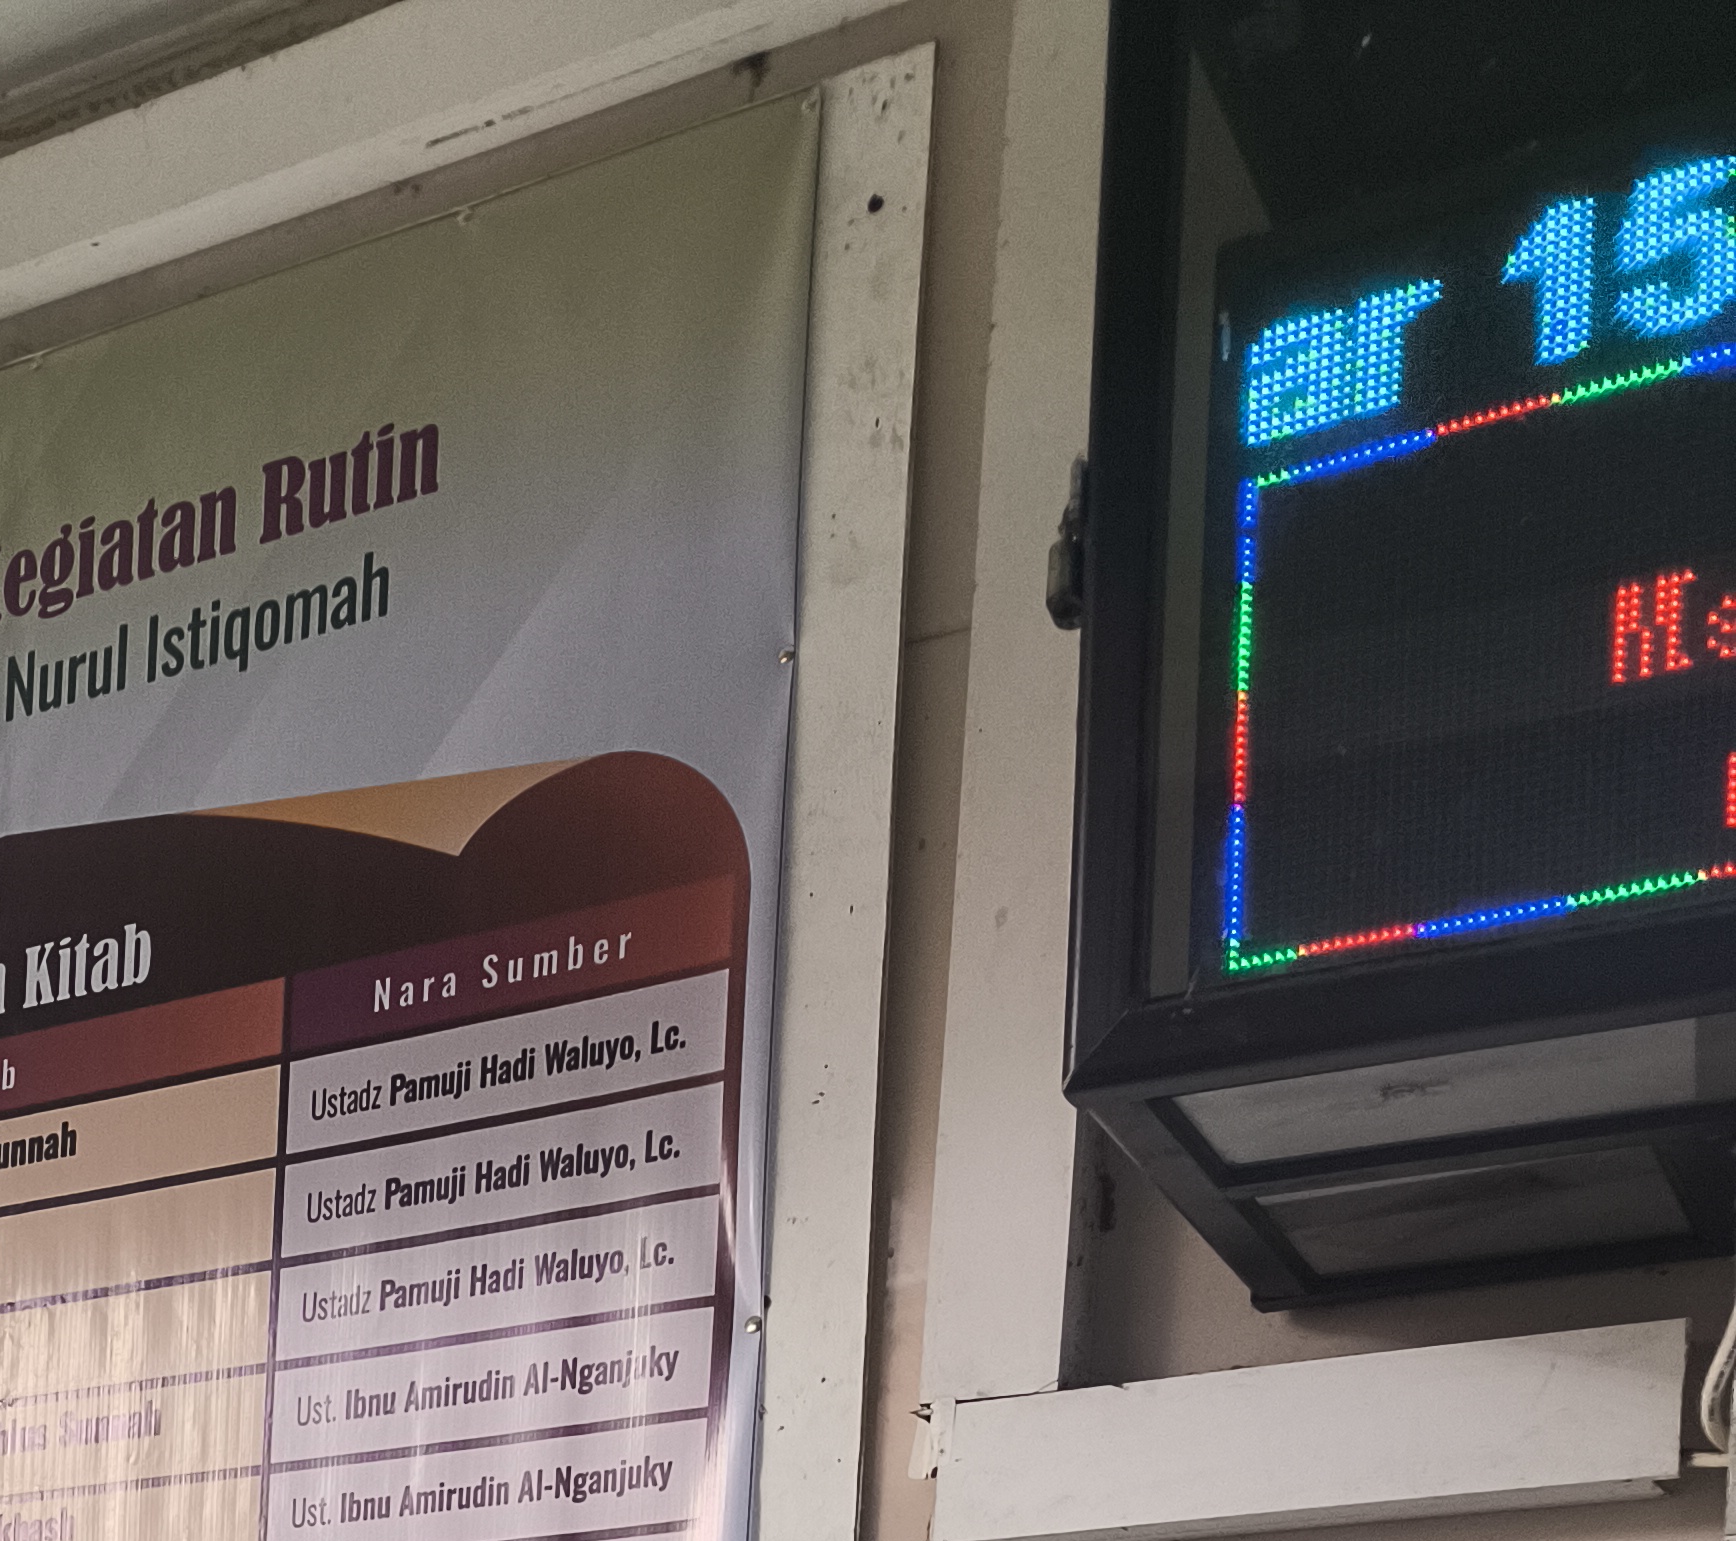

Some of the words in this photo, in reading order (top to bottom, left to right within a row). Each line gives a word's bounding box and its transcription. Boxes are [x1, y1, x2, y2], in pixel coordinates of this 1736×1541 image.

[259, 423, 440, 545] Rutin
[5, 623, 129, 723] Nurul
[146, 551, 390, 684] Istiqomah
[22, 922, 152, 1009] Kitab
[373, 972, 456, 1013] Nara
[481, 931, 632, 989] Sumber
[311, 1079, 383, 1121] Ustadz
[389, 1059, 472, 1107] Pamuji
[479, 1047, 536, 1089] Hadi
[544, 1034, 642, 1077] Waluyo,
[650, 1020, 687, 1055] Lc.
